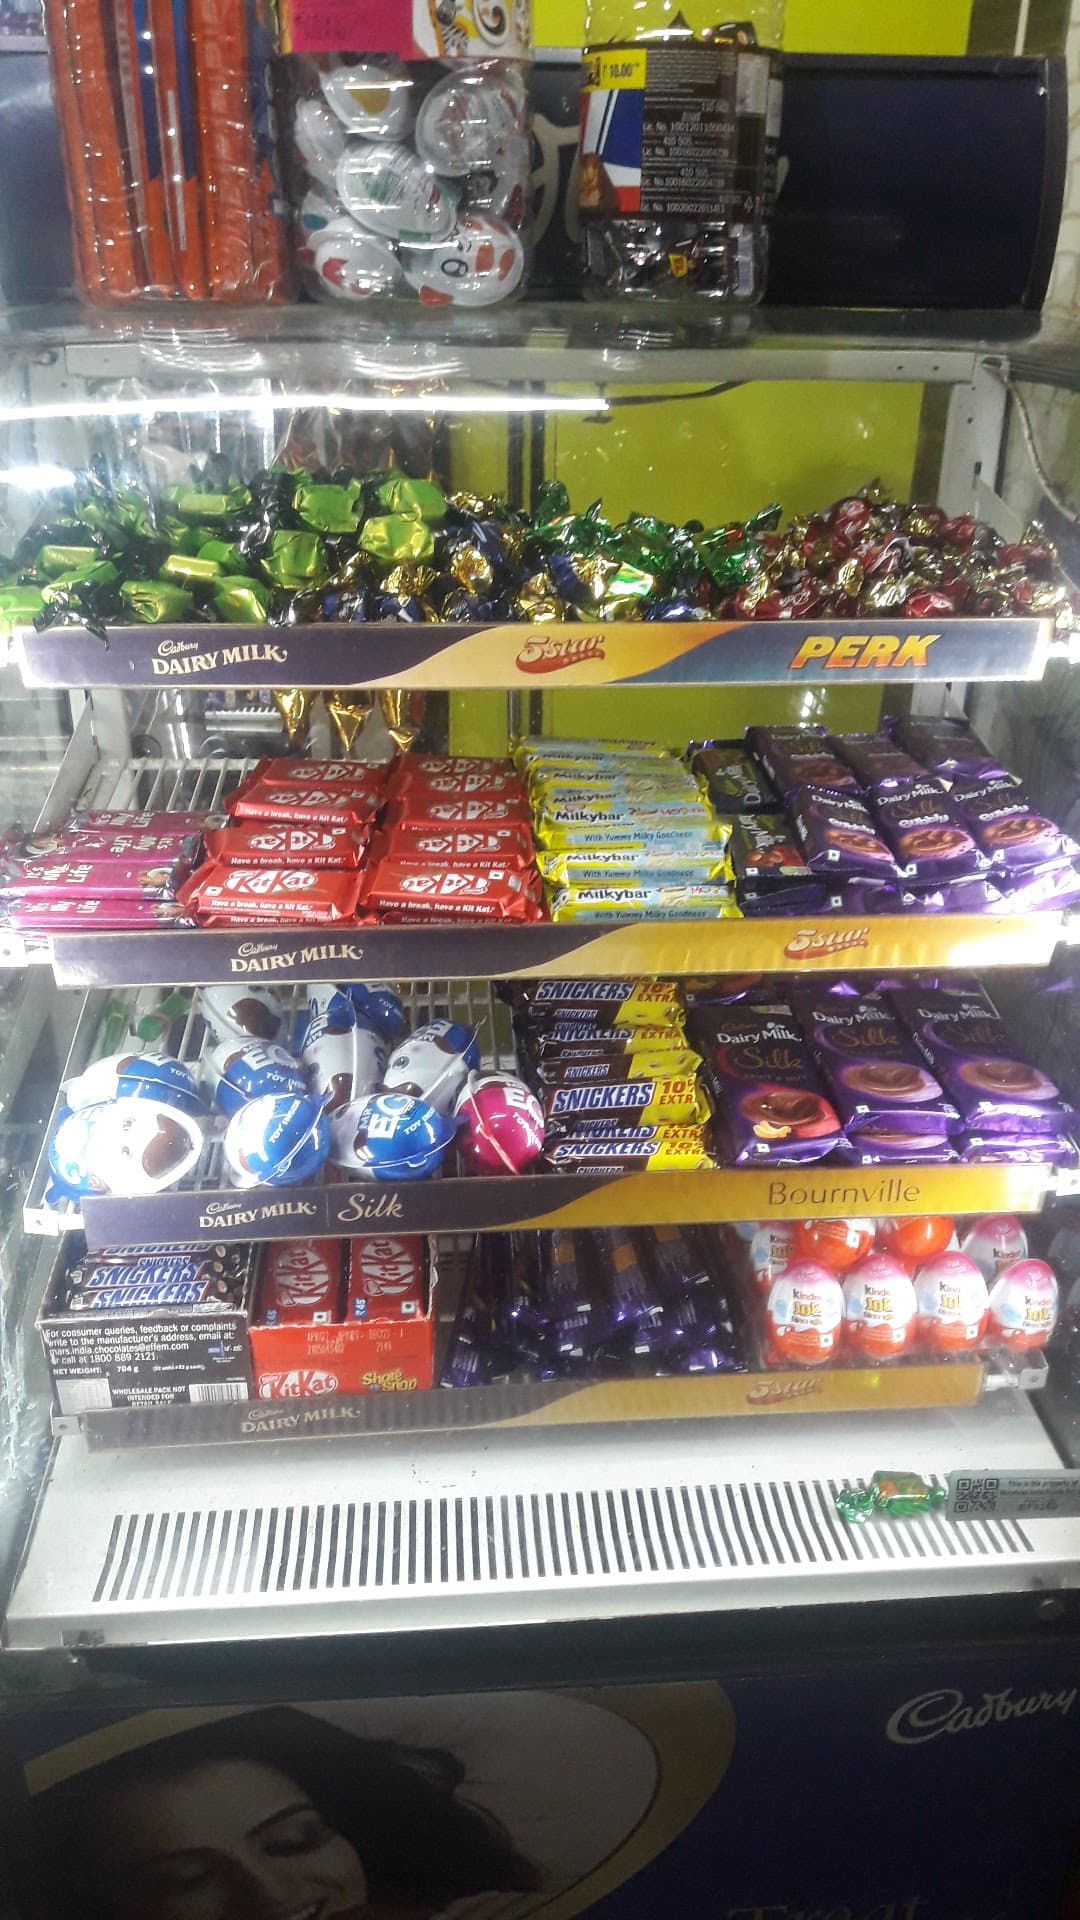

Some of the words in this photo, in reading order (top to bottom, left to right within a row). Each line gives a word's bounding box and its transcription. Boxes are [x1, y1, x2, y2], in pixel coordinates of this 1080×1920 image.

[157, 639, 199, 656] Cadbury
[789, 633, 943, 669] PERK
[151, 653, 217, 676] DAIRY
[222, 642, 288, 667] MILK
[877, 792, 911, 806] Dairy
[911, 786, 943, 798] Milk
[954, 787, 988, 802] Dairy
[555, 811, 625, 823] Milkybar
[584, 833, 603, 842] With
[604, 832, 631, 842] Yummy
[633, 831, 655, 841] Milky
[230, 857, 250, 865] Have
[286, 857, 305, 865] have
[314, 857, 327, 865] Kit
[566, 853, 639, 863] Milkybar
[66, 864, 94, 883] Life
[583, 869, 602, 878] With
[604, 869, 631, 878] Yummy
[577, 889, 651, 900] Milkybar
[260, 901, 277, 910] have
[379, 900, 399, 908] Have
[408, 901, 433, 911] break,
[434, 903, 454, 911] have
[462, 904, 474, 912] Kit
[594, 911, 613, 919] With
[615, 910, 644, 920] Yummy
[237, 942, 279, 957] Cadbury
[230, 951, 297, 973] DAIRY
[300, 945, 364, 965] MILK
[536, 981, 635, 1001] SNICKERS
[812, 1011, 855, 1026] Dairy
[856, 1010, 896, 1024] Milk
[917, 1008, 959, 1023] Dairy
[958, 1007, 992, 1019] Milk
[717, 1032, 761, 1045] Dairy
[762, 1027, 802, 1043] Milk
[265, 1071, 287, 1083] TOY
[564, 1064, 610, 1079] SNICKERS
[551, 1082, 656, 1114] SNICKERS
[268, 1122, 284, 1144] TOY
[403, 1119, 422, 1136] TOY
[553, 1141, 661, 1157] SNICKERS
[768, 1178, 921, 1206] Bournville
[199, 1210, 257, 1229] DAIRY
[260, 1201, 317, 1220] MILK
[336, 1192, 404, 1222] Silk
[86, 1262, 198, 1288] SNICKERS
[90, 1280, 209, 1308] SNICKERS
[61, 1328, 102, 1337] consumer
[104, 1326, 138, 1337] queries,
[139, 1324, 179, 1334] feedback
[191, 1322, 236, 1333] complaints
[70, 1337, 79, 1346] to
[81, 1336, 94, 1345] the
[160, 1332, 197, 1343] address,
[199, 1331, 222, 1340] email
[61, 1355, 77, 1365] call
[79, 1356, 88, 1364] at
[90, 1353, 113, 1363] 1800
[53, 1367, 68, 1375] NET
[116, 1365, 132, 1373] 704
[133, 1366, 139, 1374] g
[112, 1386, 153, 1396] WHOLESALE
[153, 1386, 172, 1395] PACK
[172, 1384, 186, 1394] NOT
[259, 1369, 339, 1399] KitKat
[241, 1414, 300, 1434] DAIRY
[303, 1406, 361, 1425] MILK
[886, 1687, 1079, 1745] Cadbury
